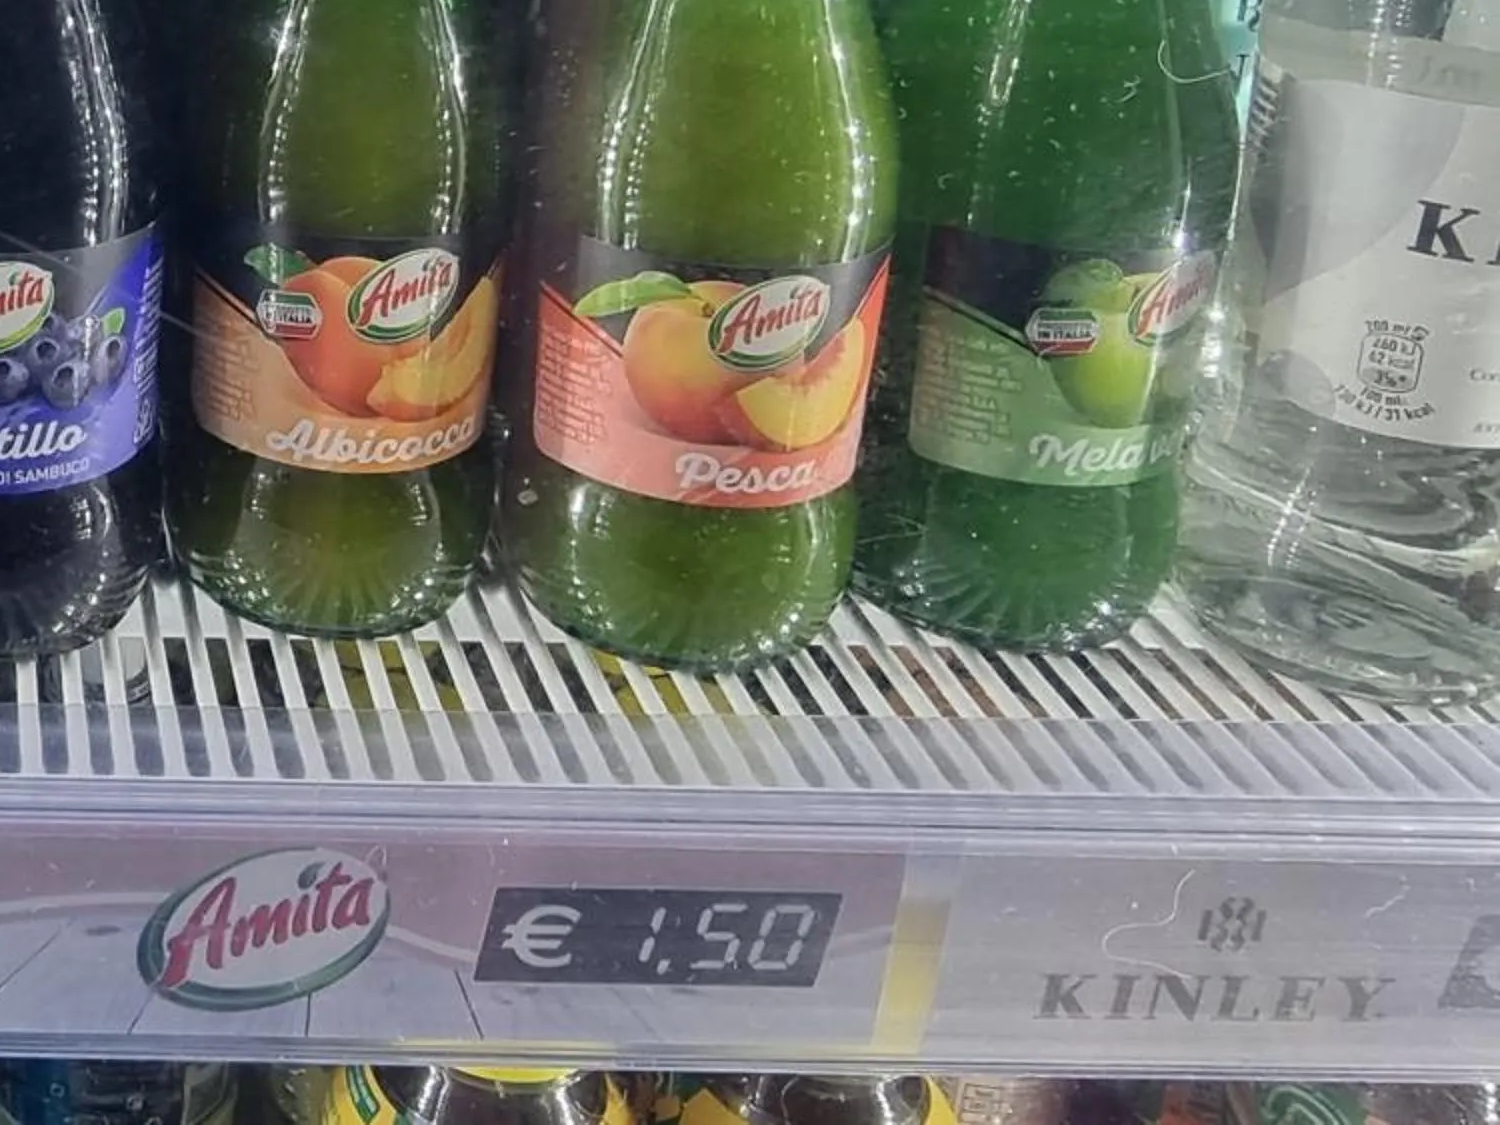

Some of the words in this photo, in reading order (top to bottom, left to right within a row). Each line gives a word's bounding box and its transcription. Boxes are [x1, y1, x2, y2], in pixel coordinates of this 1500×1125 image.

[358, 258, 454, 326] Amita
[717, 286, 822, 355] Amita
[15, 456, 90, 484] SAMBUCO
[675, 451, 817, 495] Pesca
[1028, 432, 1145, 476] Mela
[157, 860, 376, 989] Amita
[1032, 973, 1397, 1023] KINLEY
